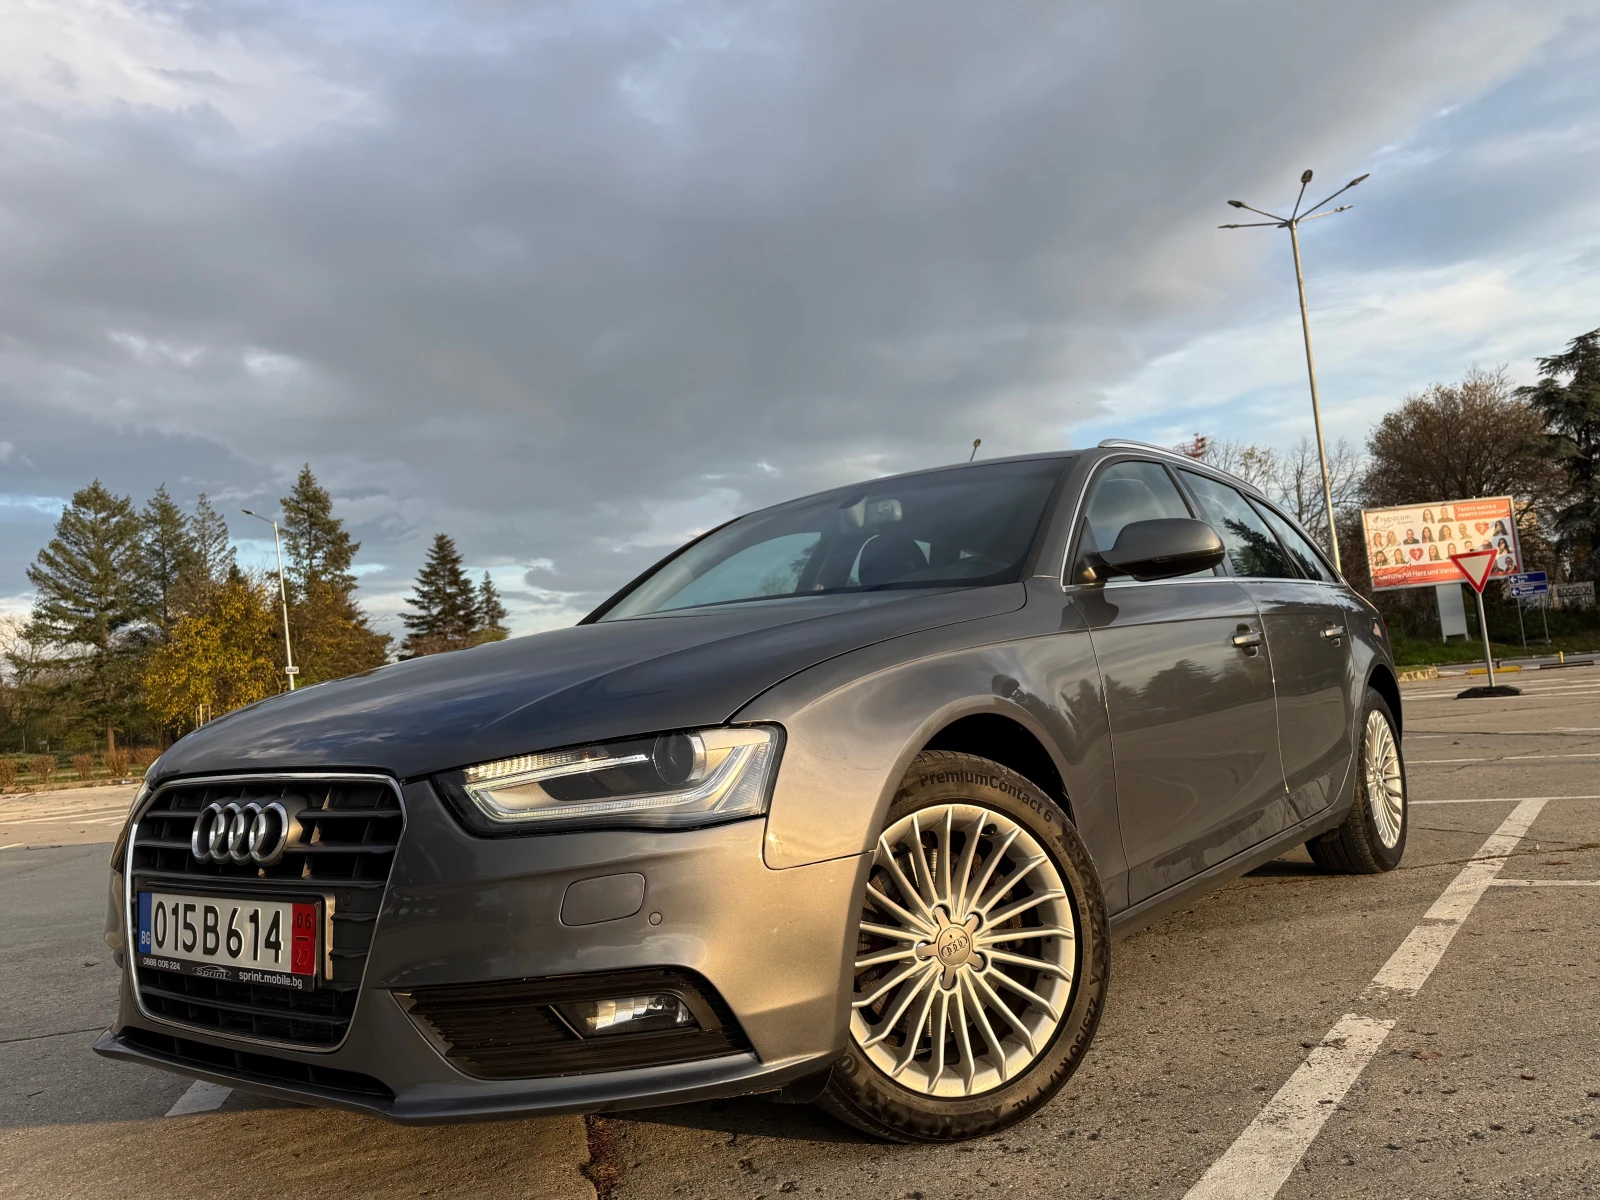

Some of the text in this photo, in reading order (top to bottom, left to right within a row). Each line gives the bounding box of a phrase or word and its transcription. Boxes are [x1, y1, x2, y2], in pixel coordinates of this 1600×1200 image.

[918, 769, 1043, 814] PremiumContact
[1043, 808, 1054, 822] 6
[296, 912, 312, 930] 06
[141, 931, 150, 945] BG
[170, 960, 180, 971] 224
[196, 968, 228, 980] Sprint
[239, 971, 303, 989] sprint.mobile.bg
[1070, 997, 1099, 1058] 225/50
[1060, 1057, 1073, 1070] R
[1049, 1070, 1063, 1087] 17
[1012, 1095, 1033, 1114] XL
